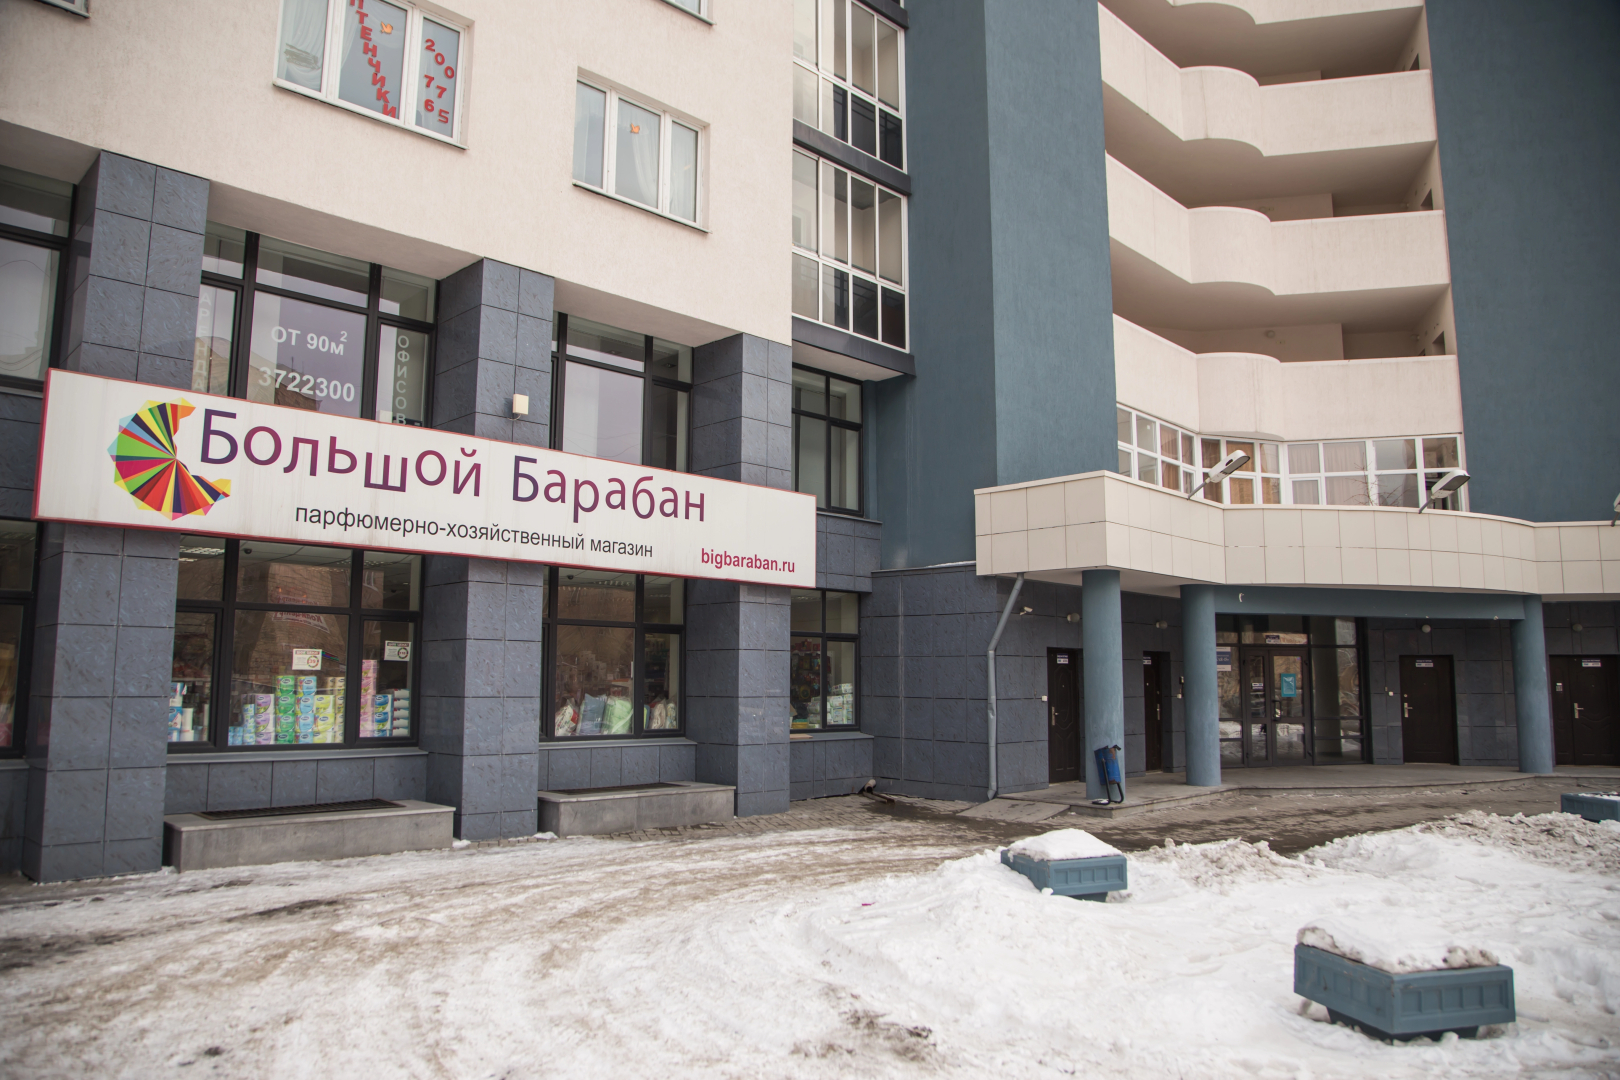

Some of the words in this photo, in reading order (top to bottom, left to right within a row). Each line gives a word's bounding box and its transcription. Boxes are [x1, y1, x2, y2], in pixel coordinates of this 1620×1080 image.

[271, 326, 300, 346] ОТ
[258, 366, 355, 403] 3722300
[512, 455, 705, 524] Барабан
[295, 507, 585, 551] парфюмерно-хозяйственный
[590, 537, 654, 558] магазин
[701, 547, 796, 573] bigbaraban.ru
